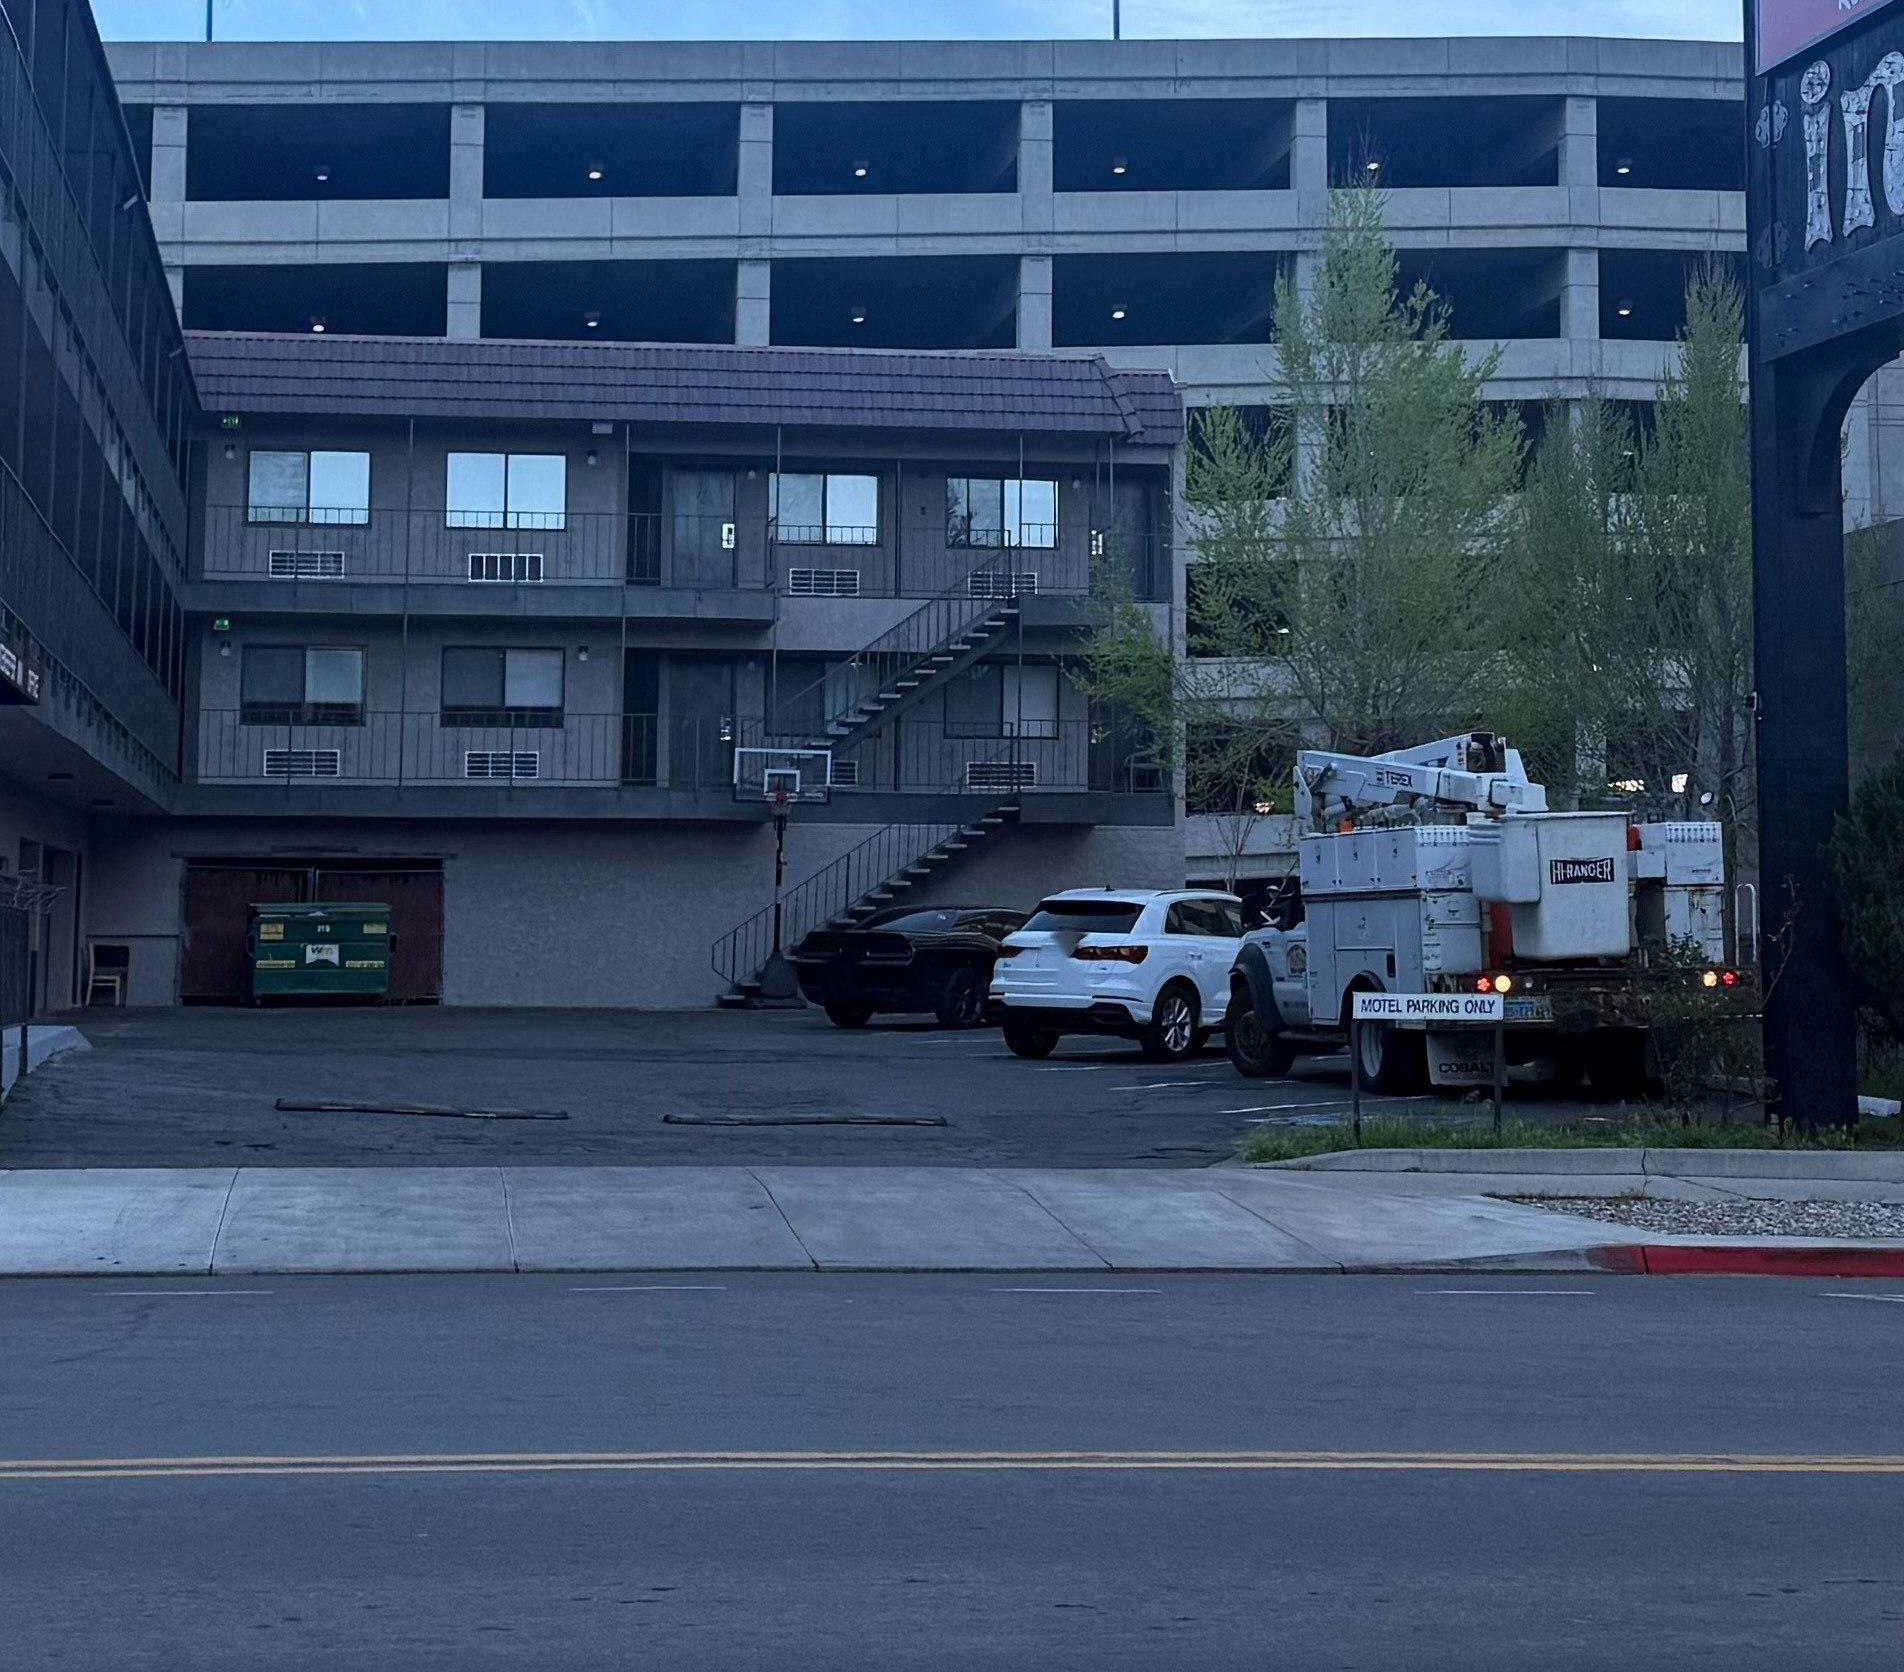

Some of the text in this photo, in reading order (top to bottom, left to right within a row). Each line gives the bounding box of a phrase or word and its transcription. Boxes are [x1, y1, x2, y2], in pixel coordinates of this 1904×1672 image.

[1551, 858, 1612, 884] HI-RANGER
[1360, 998, 1403, 1013] MOTEL
[1406, 999, 1460, 1014] PARKING
[1464, 999, 1496, 1015] ONLY
